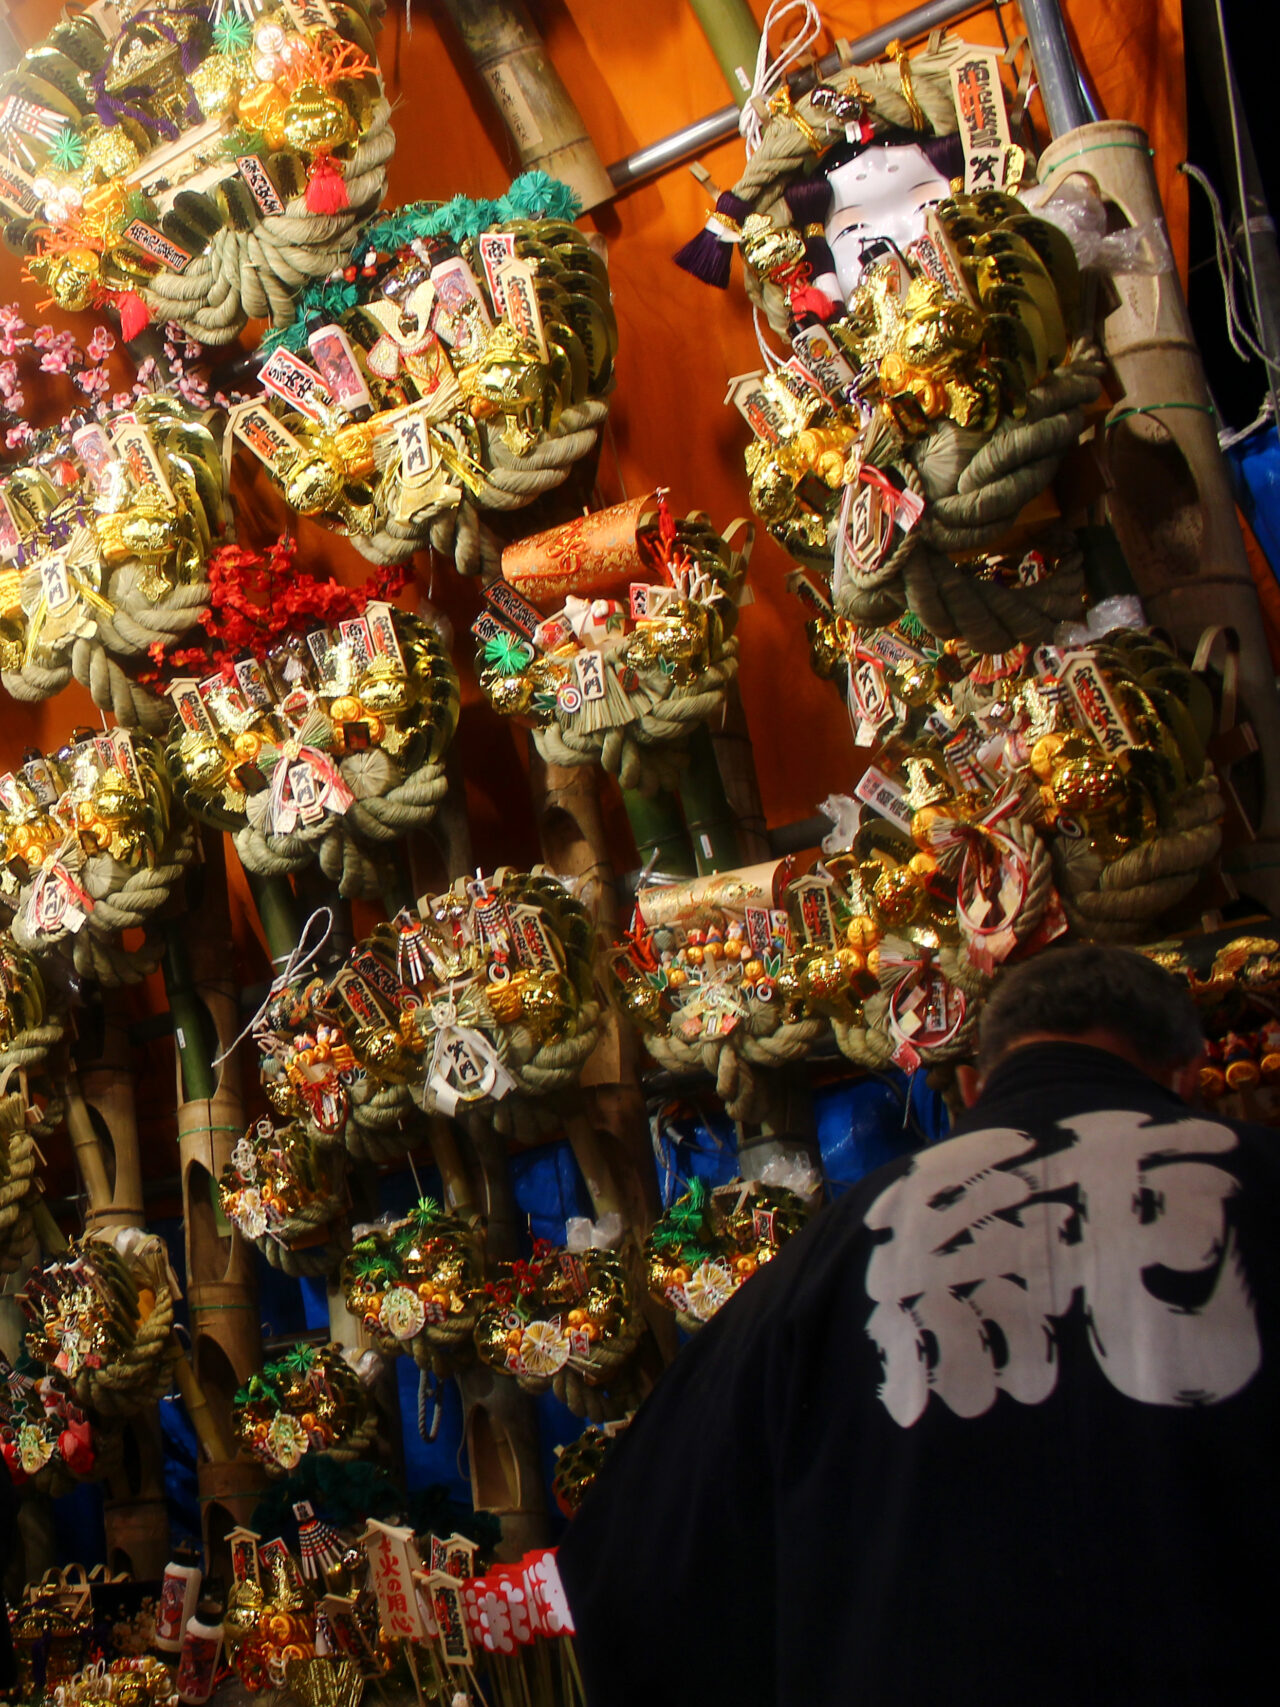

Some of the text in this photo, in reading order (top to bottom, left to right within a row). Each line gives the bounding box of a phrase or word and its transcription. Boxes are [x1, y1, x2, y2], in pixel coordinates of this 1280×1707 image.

[128, 222, 189, 268] 商売繁昌
[400, 419, 426, 471] 笑門
[44, 564, 66, 604] 笑門
[578, 655, 603, 696] 笑門
[1072, 666, 1128, 754] 家内安全
[291, 766, 316, 804] 笑門
[379, 1556, 415, 1634] 火の用心
